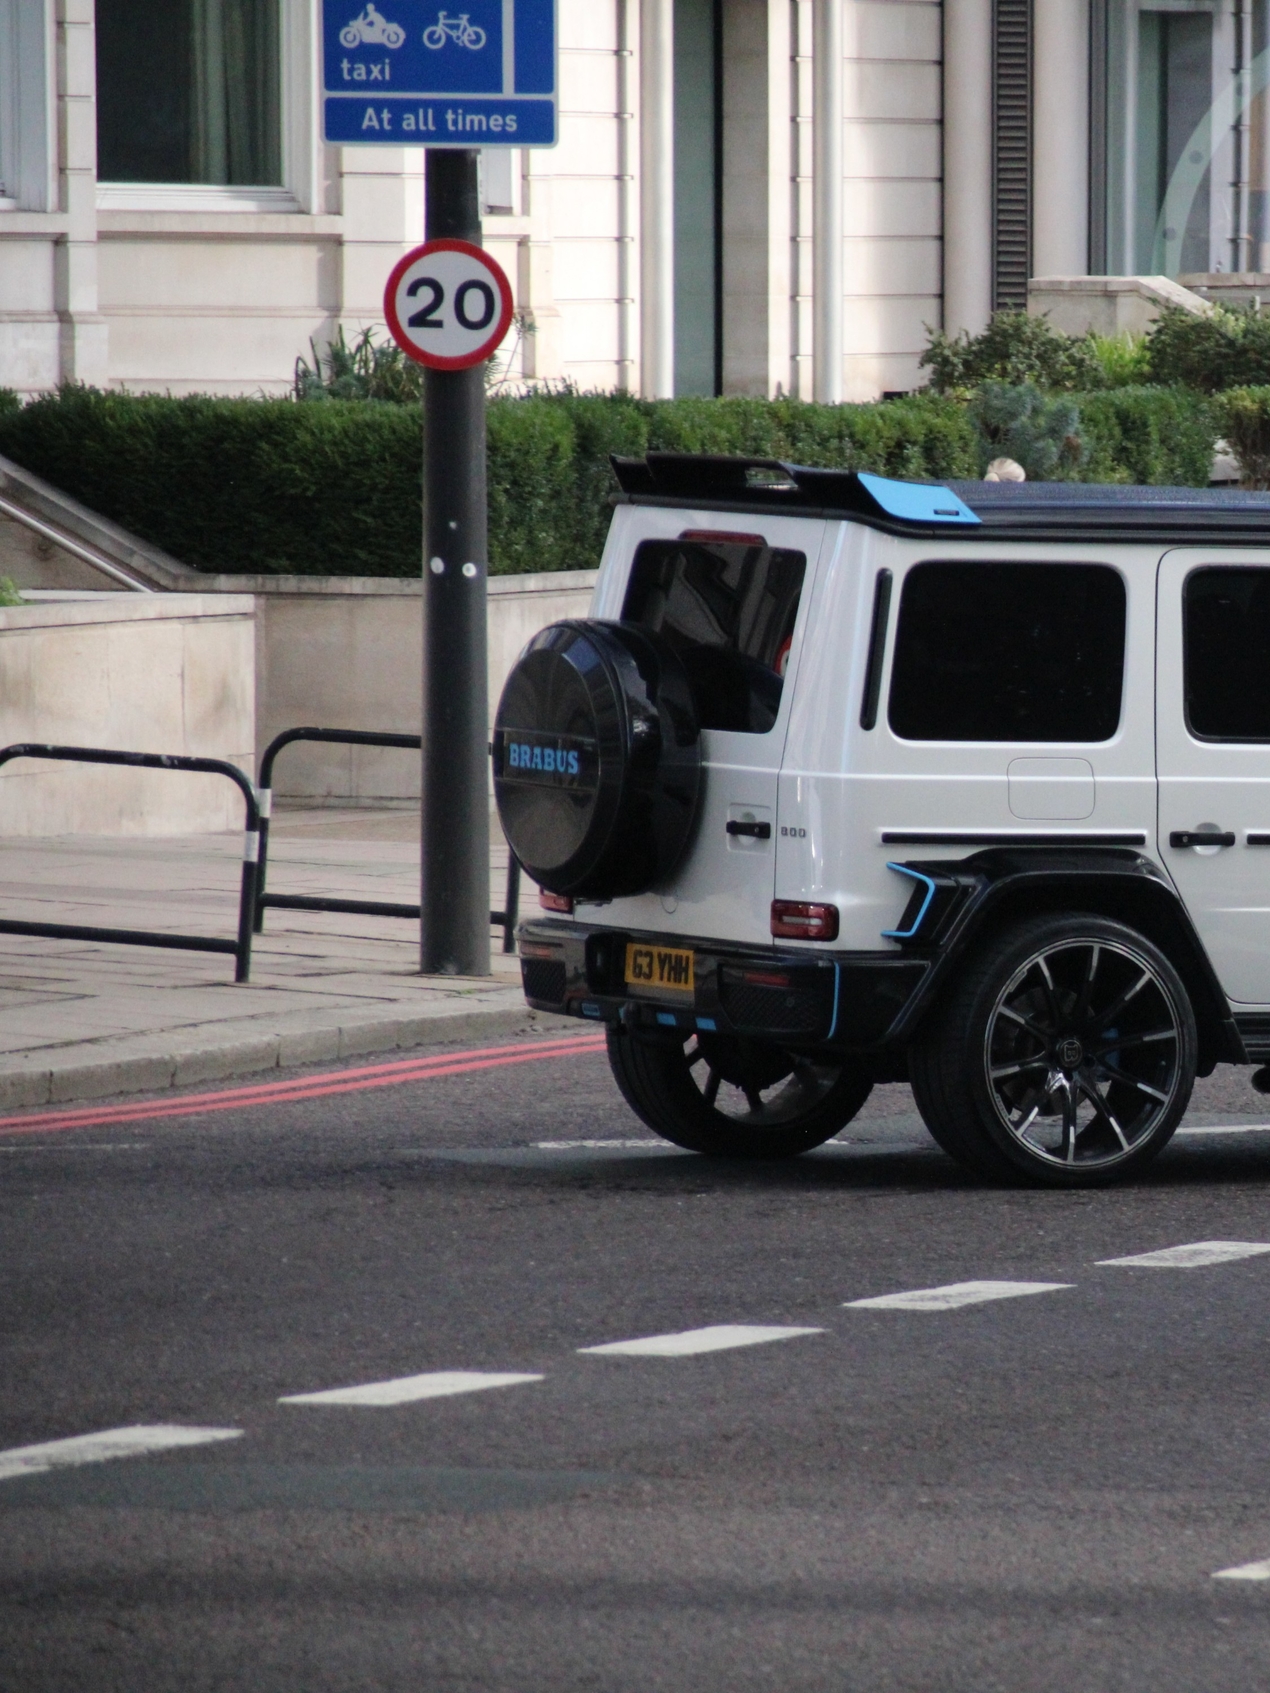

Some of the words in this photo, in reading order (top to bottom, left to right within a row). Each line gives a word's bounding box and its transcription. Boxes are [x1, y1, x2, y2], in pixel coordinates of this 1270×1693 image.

[341, 58, 391, 81] taxi
[361, 107, 392, 131] At
[402, 108, 436, 132] all
[446, 109, 518, 132] times
[405, 276, 496, 331] 20
[509, 743, 579, 775] BRABUS
[632, 949, 654, 981] G3
[656, 951, 690, 985] YHH
